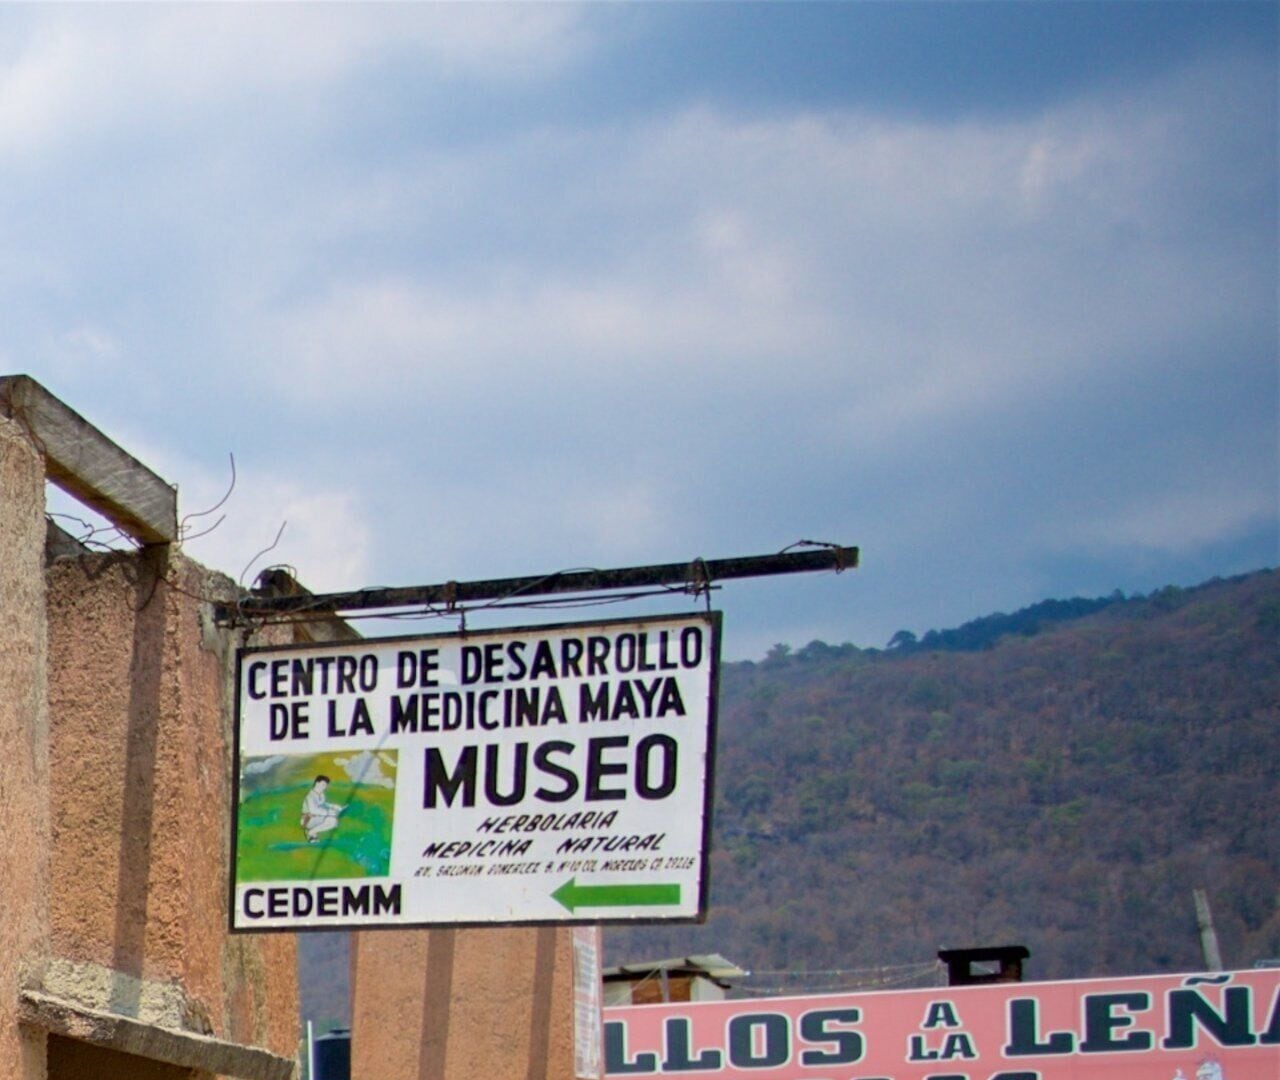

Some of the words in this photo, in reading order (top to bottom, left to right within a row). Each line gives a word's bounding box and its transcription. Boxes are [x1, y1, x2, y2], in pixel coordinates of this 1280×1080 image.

[247, 653, 379, 700] CENTRO
[396, 648, 440, 690] DE
[460, 626, 703, 687] DESARROLLO
[268, 702, 310, 742] DE
[327, 697, 375, 738] LA
[390, 686, 567, 735] MEDICINA
[578, 676, 687, 724] MAYA
[422, 732, 679, 810] MUSEO
[476, 810, 620, 834] HERBOLARIA
[421, 839, 534, 859] MEDICINA
[555, 833, 667, 855] NATURAL
[243, 883, 402, 920] CEDEMM
[922, 1001, 959, 1028] A
[1005, 974, 1280, 1057] LEÑ
[909, 1032, 976, 1062] LA
